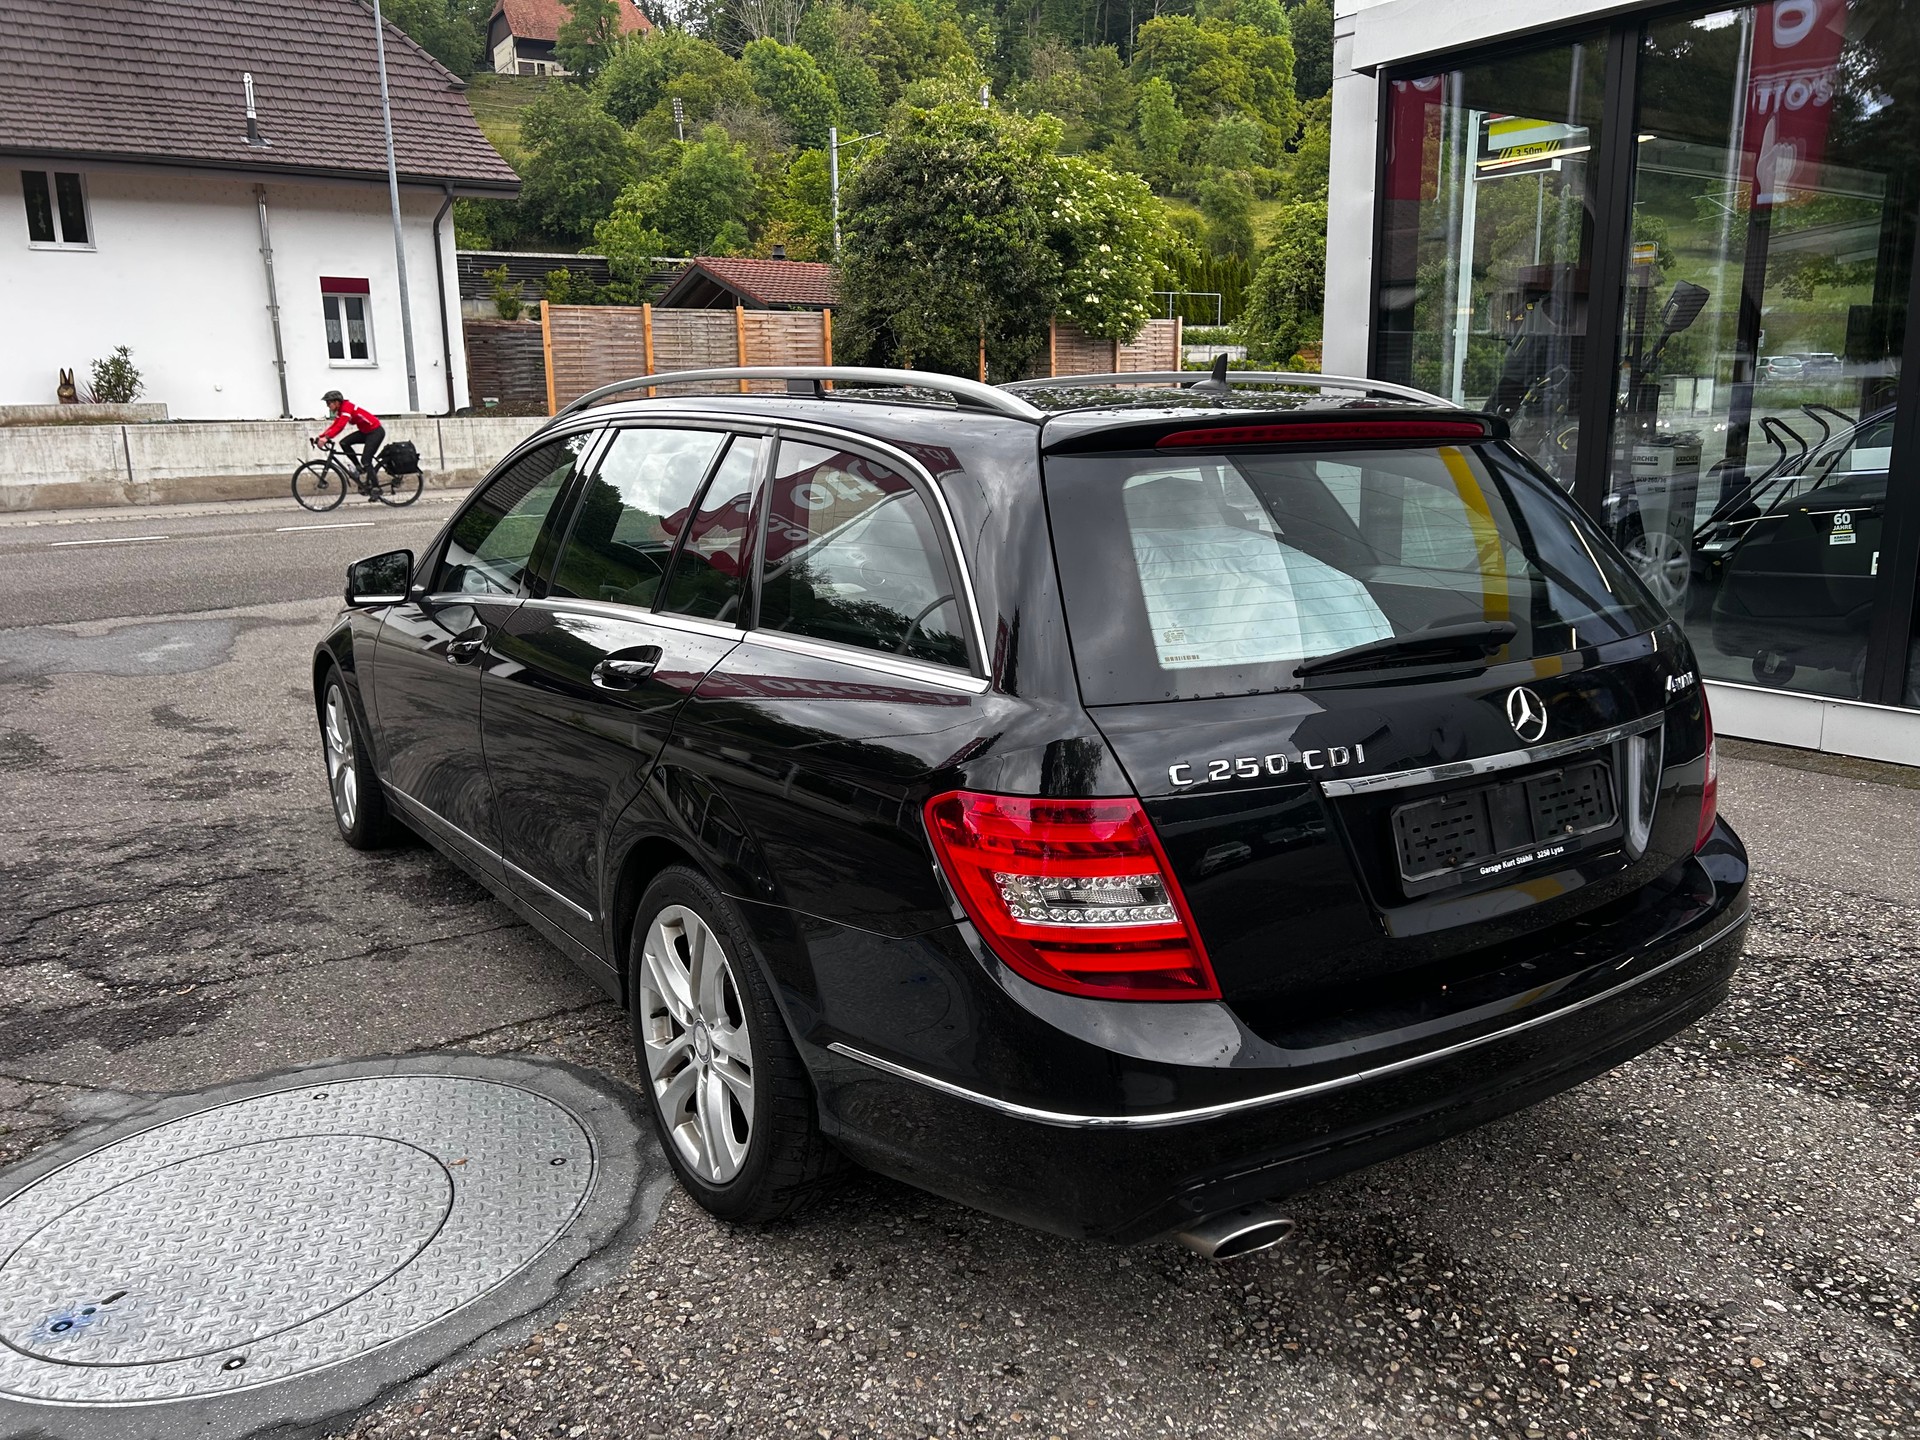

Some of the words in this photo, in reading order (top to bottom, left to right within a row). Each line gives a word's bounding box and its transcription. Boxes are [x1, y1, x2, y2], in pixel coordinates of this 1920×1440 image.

[1751, 72, 1834, 115] TTO'S
[1832, 523, 1853, 531] JAHRE
[1833, 512, 1851, 526] 60
[1169, 763, 1194, 787] C
[1208, 753, 1289, 782] 250
[1302, 744, 1366, 771] CDI
[1480, 864, 1502, 875] Garage
[1502, 859, 1516, 869] Kurt
[1536, 848, 1551, 859] 3250
[1551, 846, 1564, 856] Lyss
